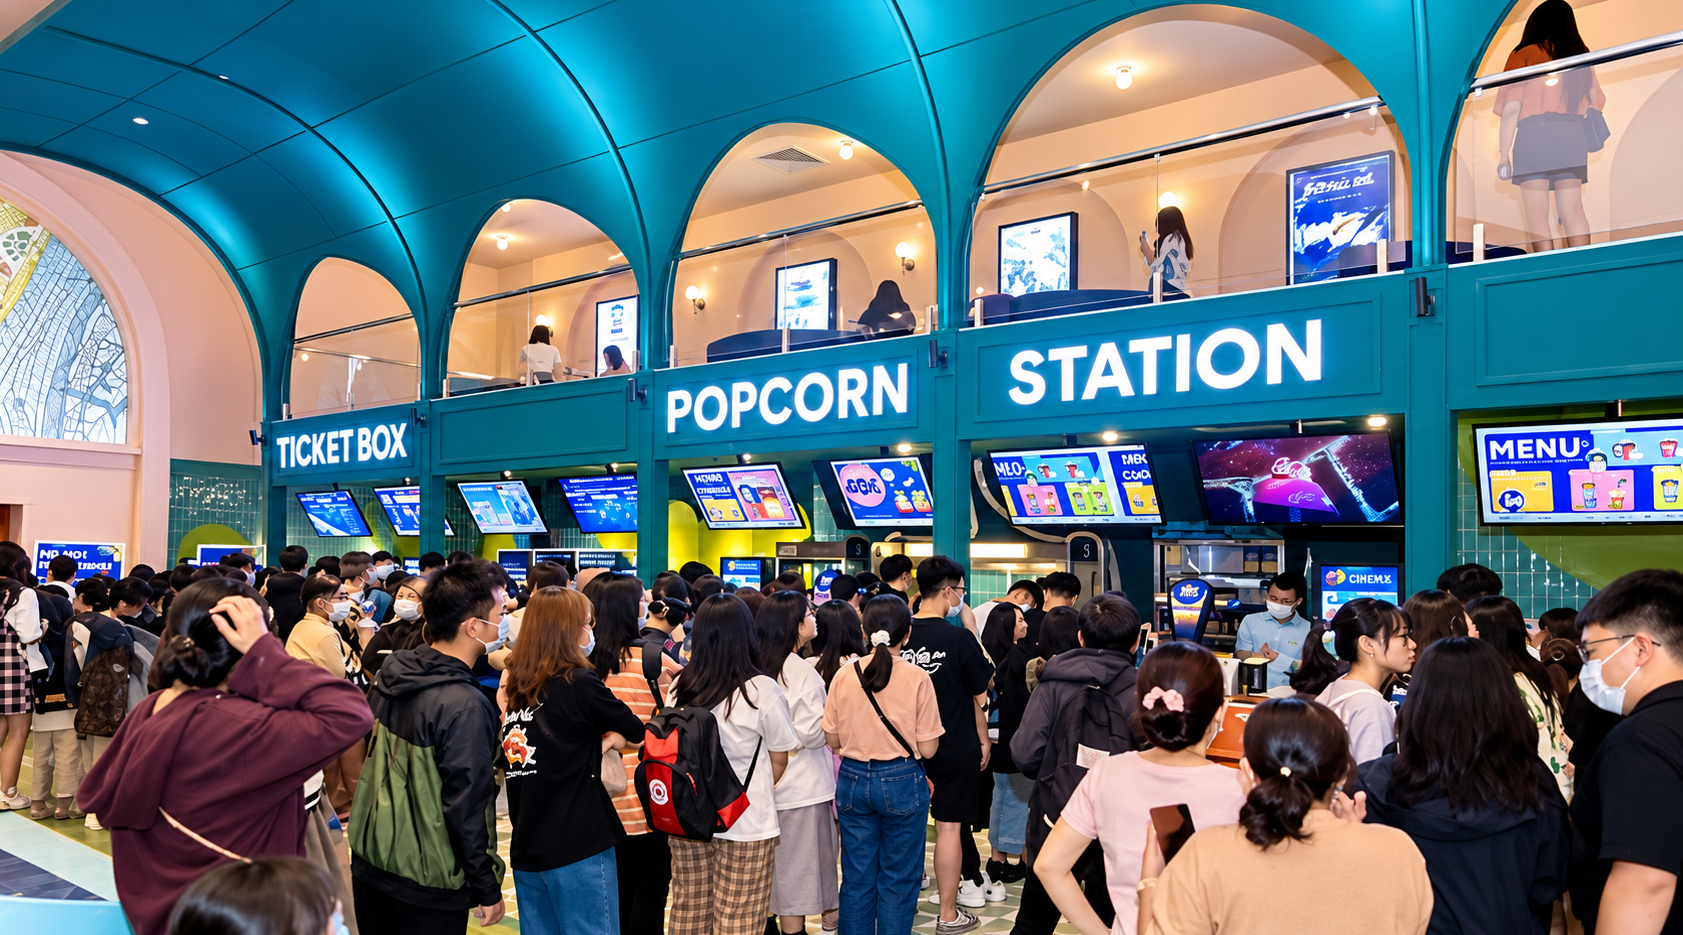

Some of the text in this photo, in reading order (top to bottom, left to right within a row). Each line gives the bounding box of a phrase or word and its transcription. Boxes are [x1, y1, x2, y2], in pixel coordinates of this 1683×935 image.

[1008, 319, 1322, 406] STATION
[666, 362, 909, 434] POPCORN
[276, 422, 408, 469] TICKET BOX
[1489, 437, 1580, 460] MENU
